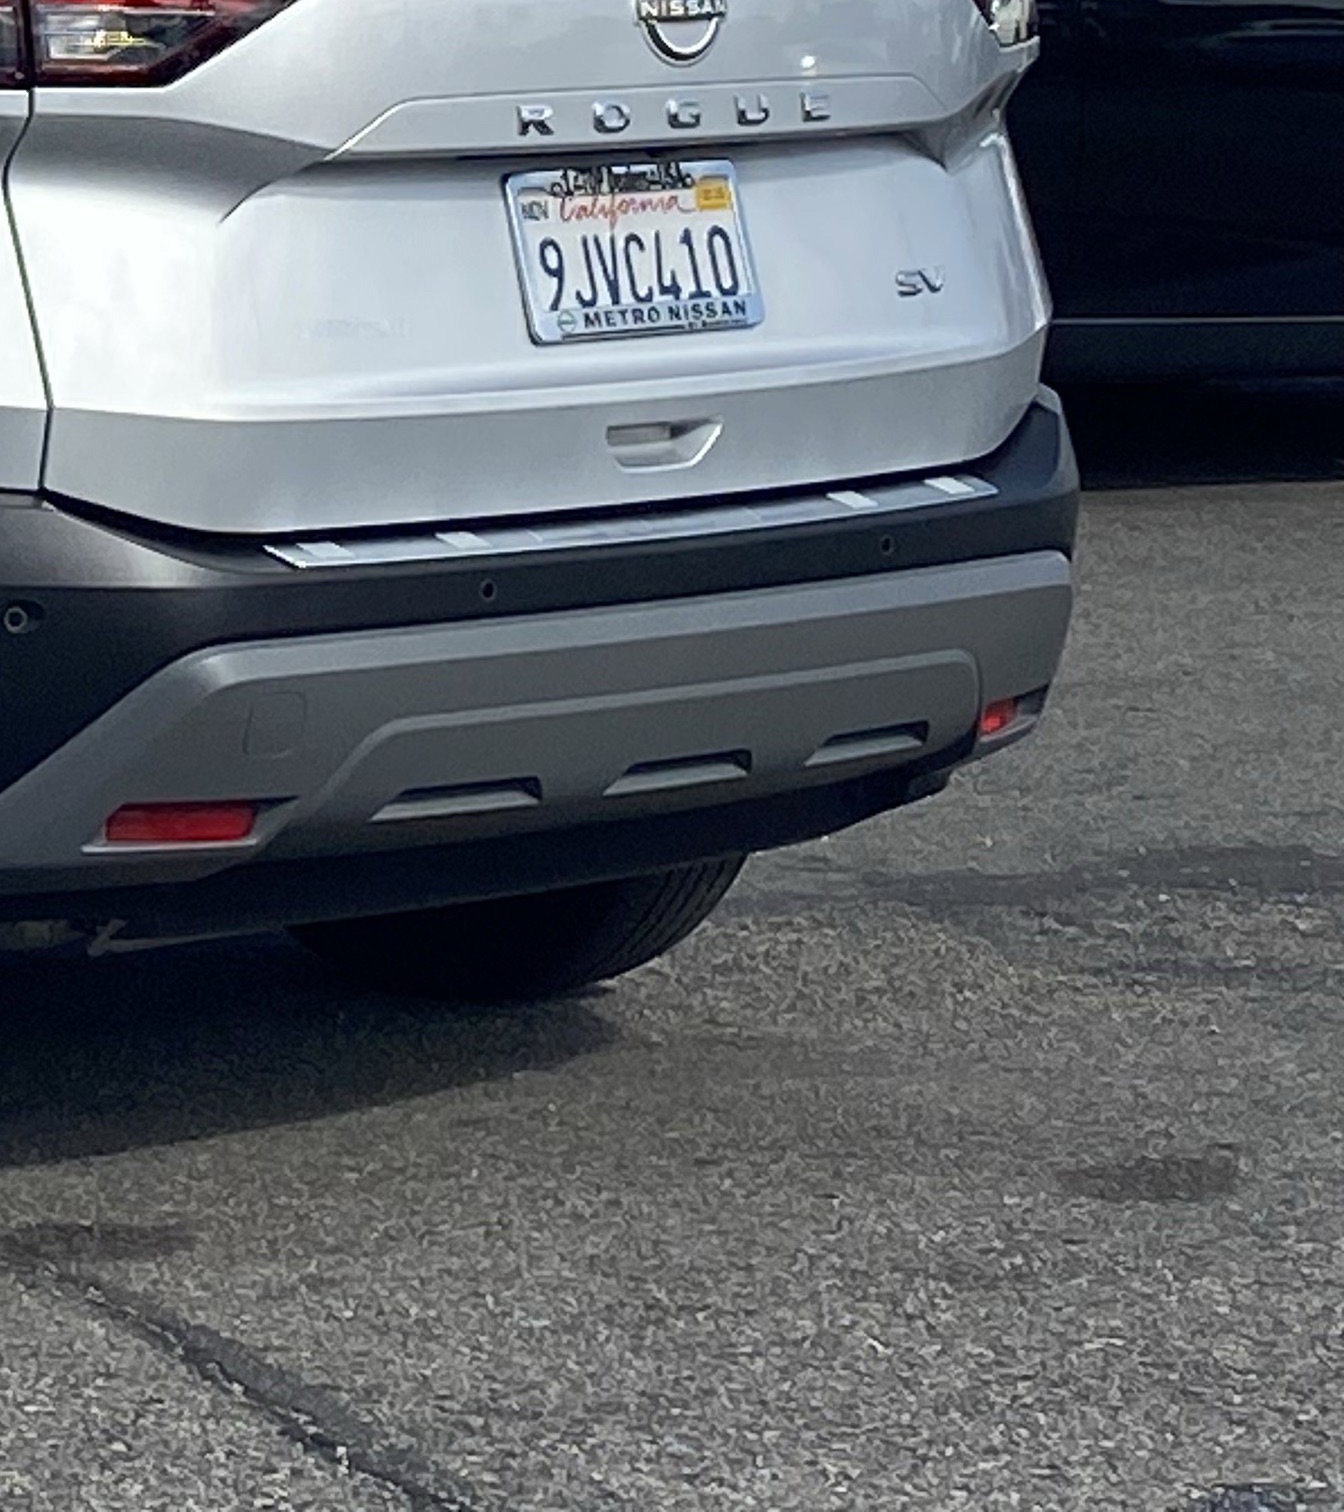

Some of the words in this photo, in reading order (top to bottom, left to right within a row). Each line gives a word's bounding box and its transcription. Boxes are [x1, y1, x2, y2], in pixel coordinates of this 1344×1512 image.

[516, 89, 831, 137] ROGUE
[558, 192, 697, 230] California
[538, 224, 740, 312] 9JVC410
[894, 265, 947, 299] SV
[582, 305, 661, 330] METRO
[667, 298, 748, 326] NISSAN
